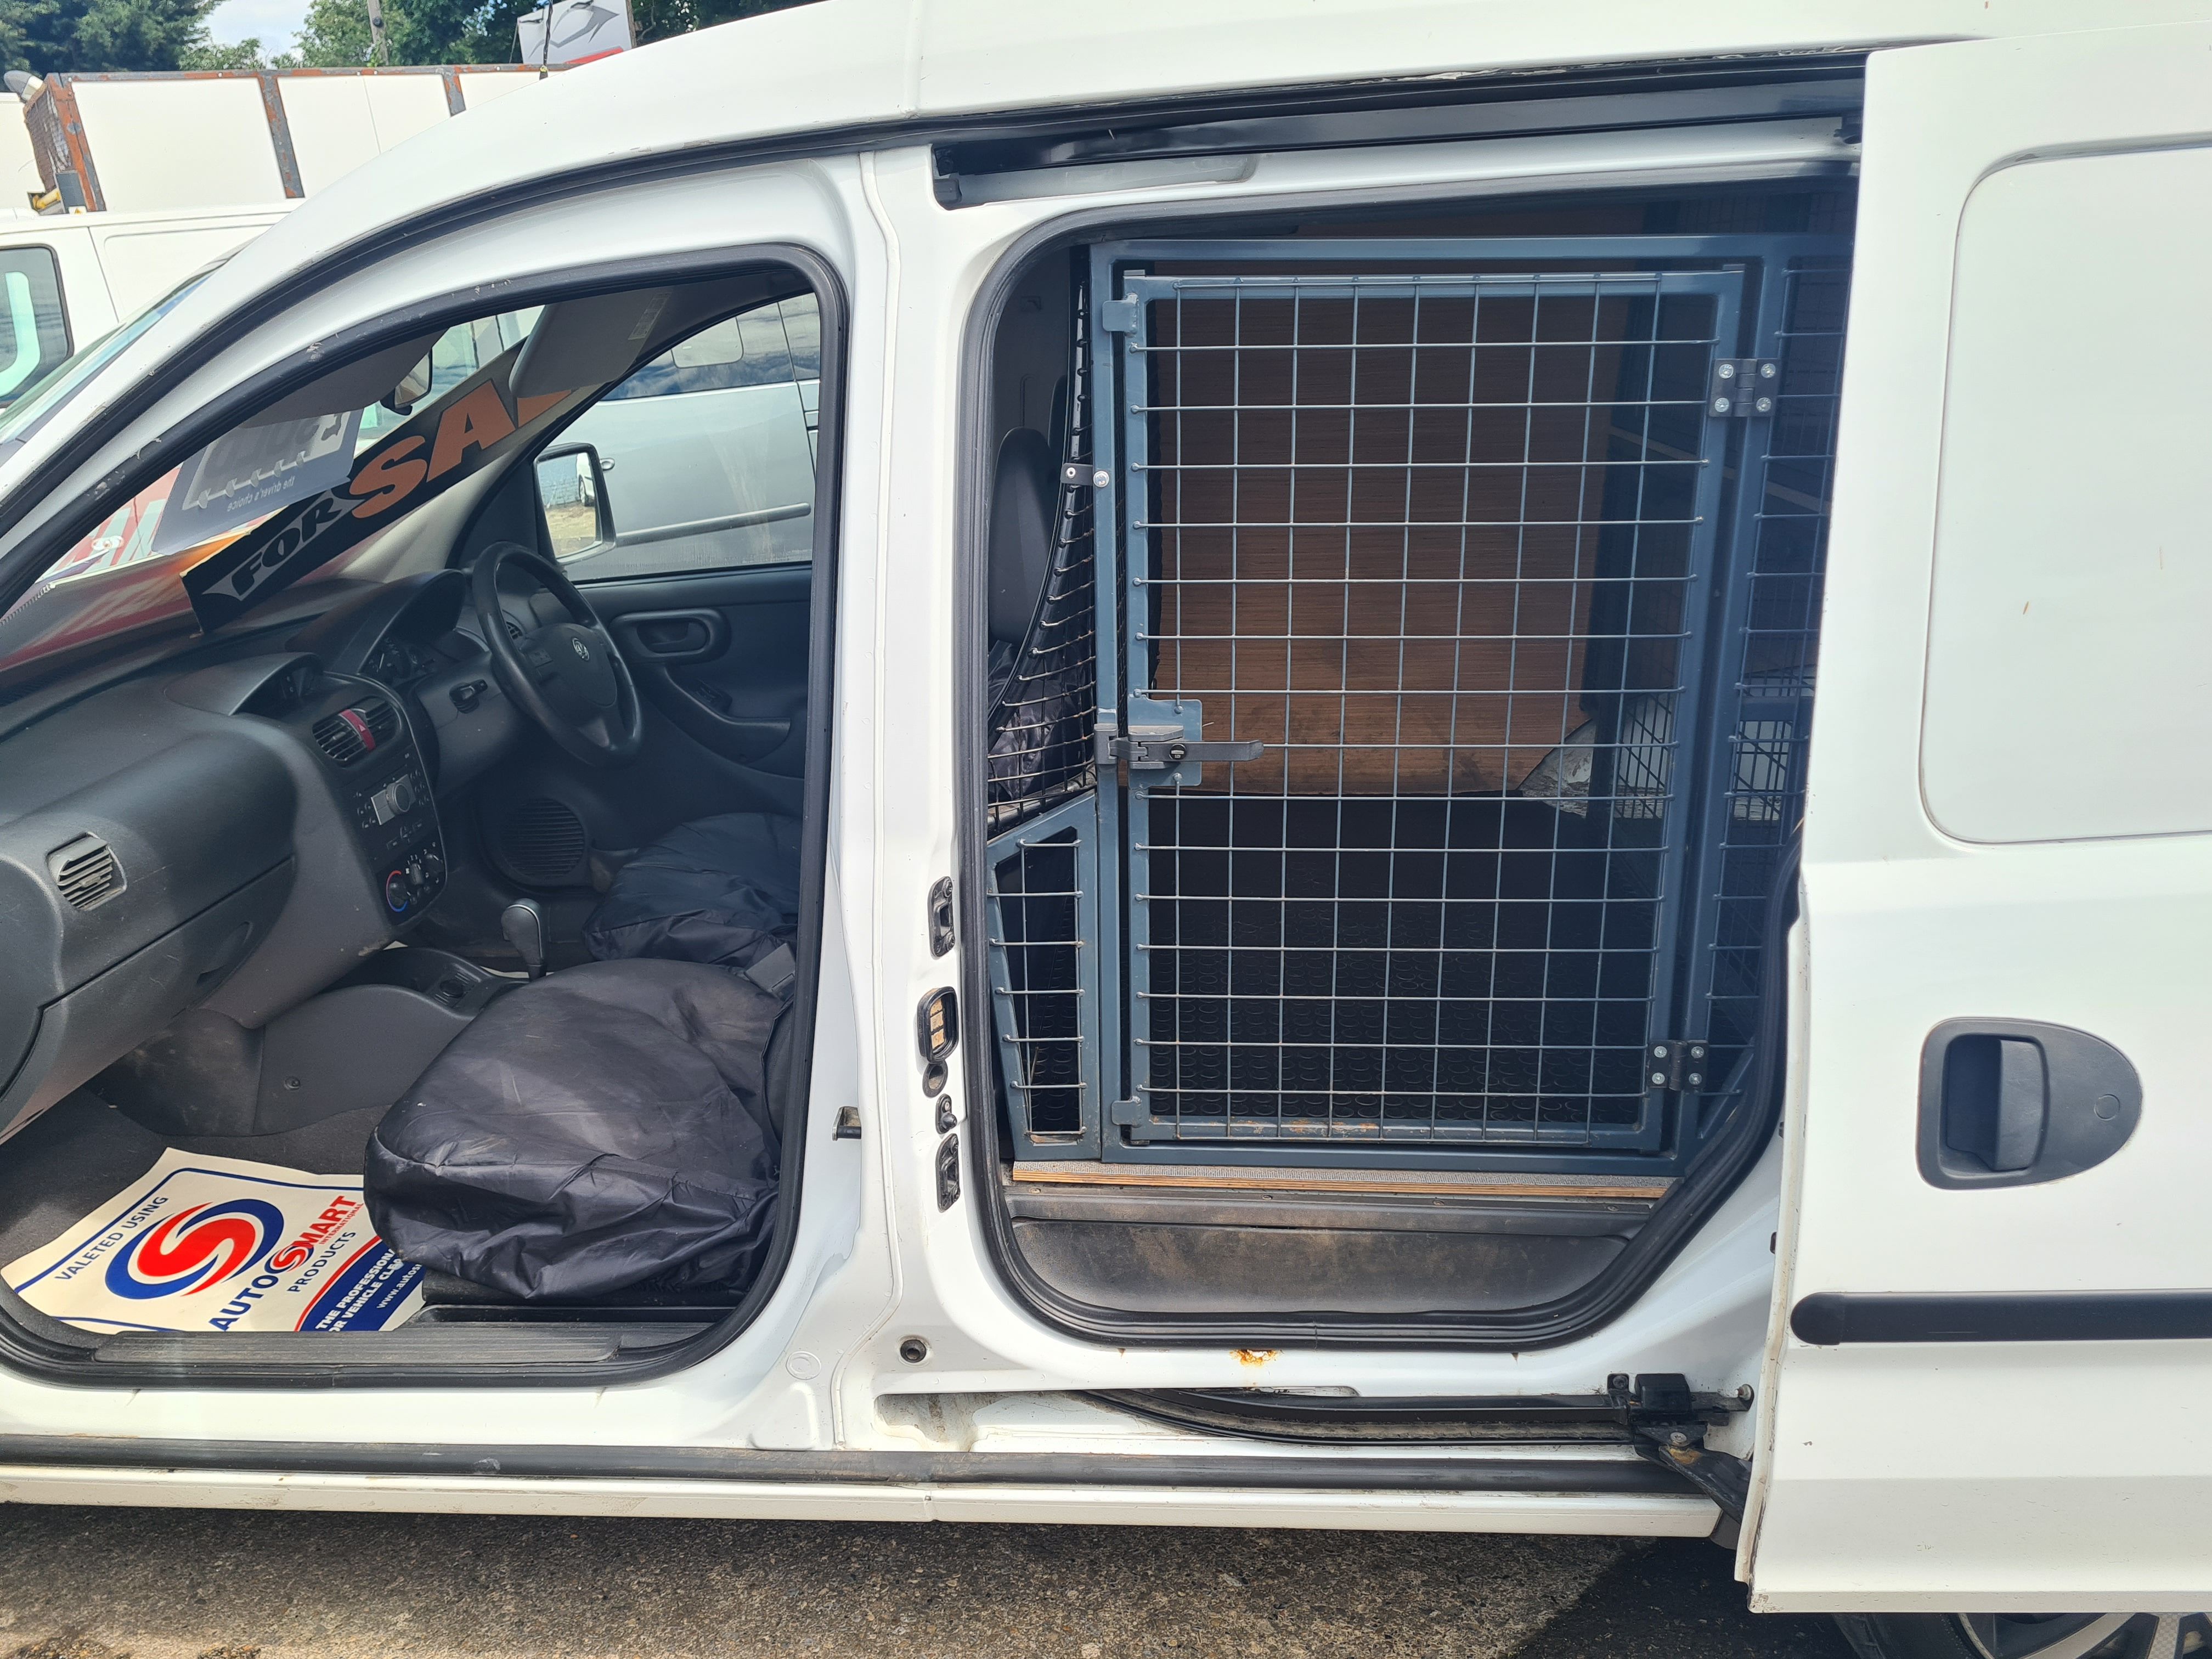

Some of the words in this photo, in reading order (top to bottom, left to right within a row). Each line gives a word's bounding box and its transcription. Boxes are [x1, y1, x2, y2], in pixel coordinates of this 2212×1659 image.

[229, 496, 345, 596] FOR
[54, 1232, 124, 1279] VALETED
[121, 1197, 169, 1228] USING
[319, 1203, 364, 1244] INTERNATIONAL
[286, 1232, 357, 1293] PRODUCTS
[315, 1310, 341, 1329] THE
[341, 1281, 383, 1318] VEHICLE
